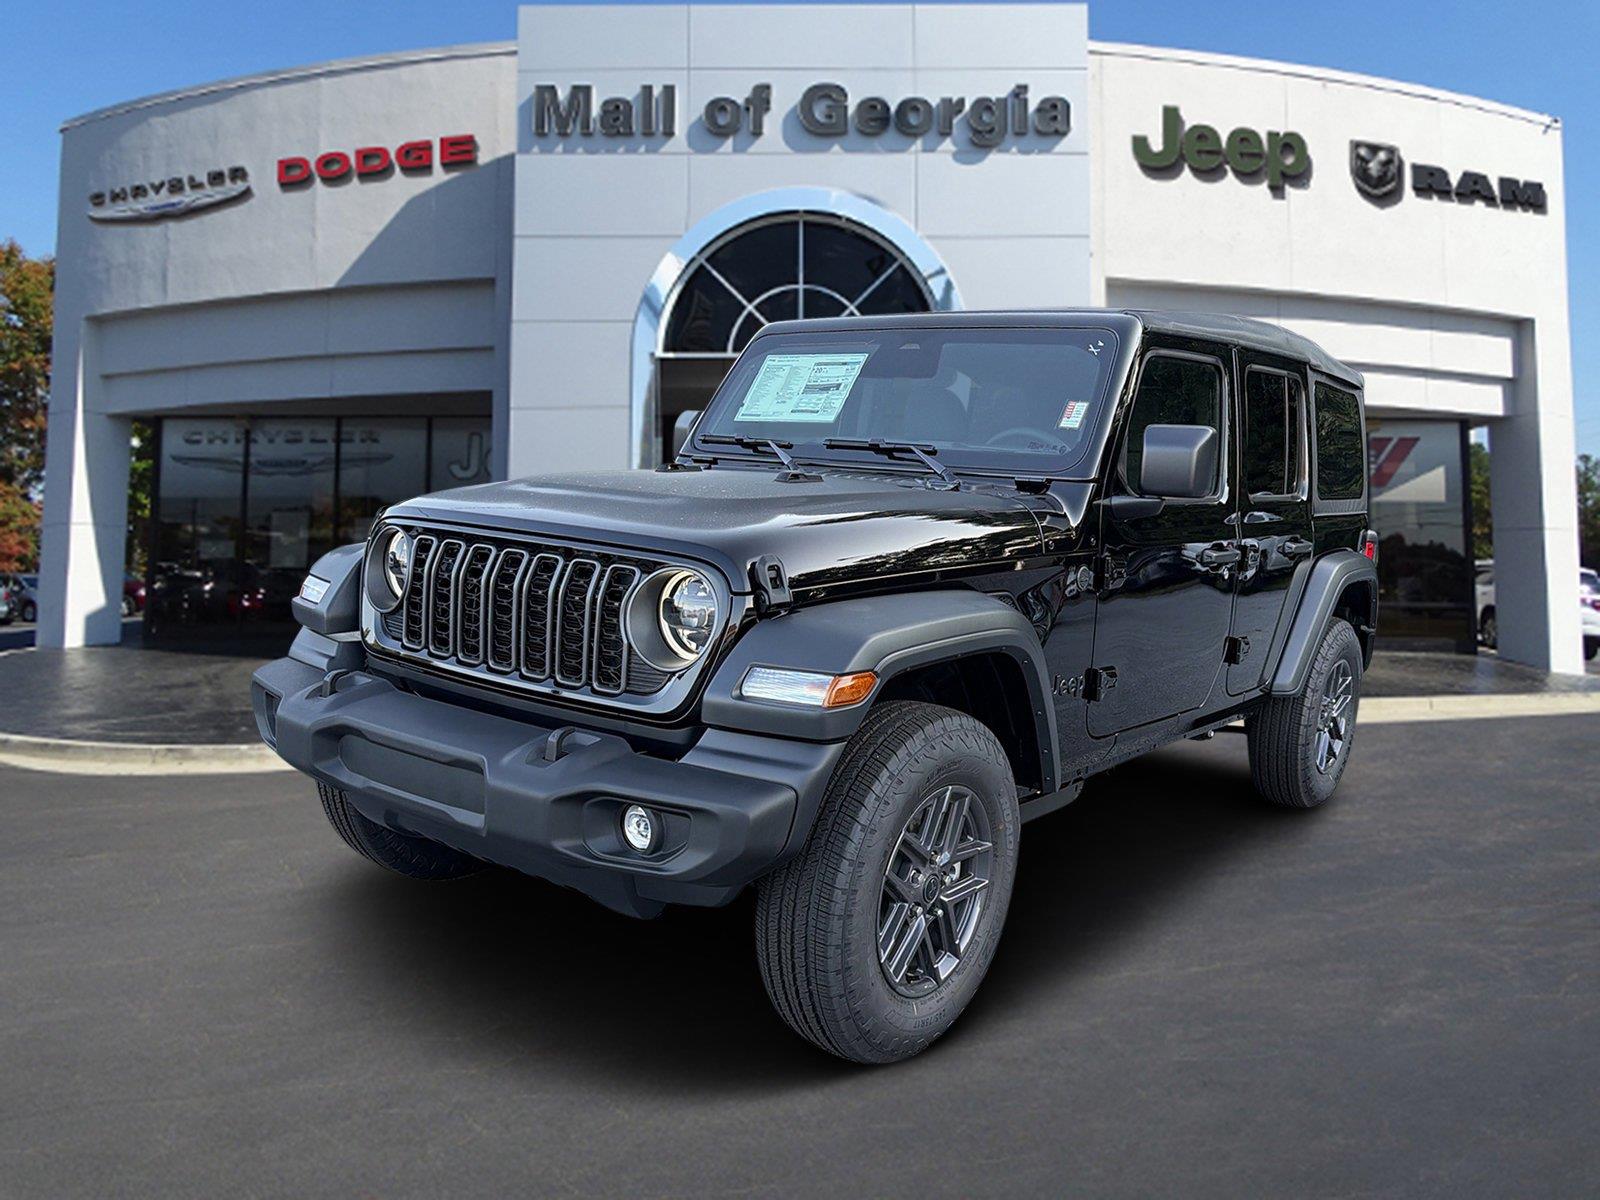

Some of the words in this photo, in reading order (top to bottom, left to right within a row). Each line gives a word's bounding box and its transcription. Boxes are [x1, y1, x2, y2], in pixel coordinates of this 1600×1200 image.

[534, 84, 676, 136] Mall
[704, 83, 771, 136] of
[799, 82, 1071, 147] Georgia
[277, 134, 477, 184] DODGE
[1131, 105, 1308, 188] Jeep
[89, 166, 249, 207] CHRYSLER
[1411, 162, 1546, 212] RAM
